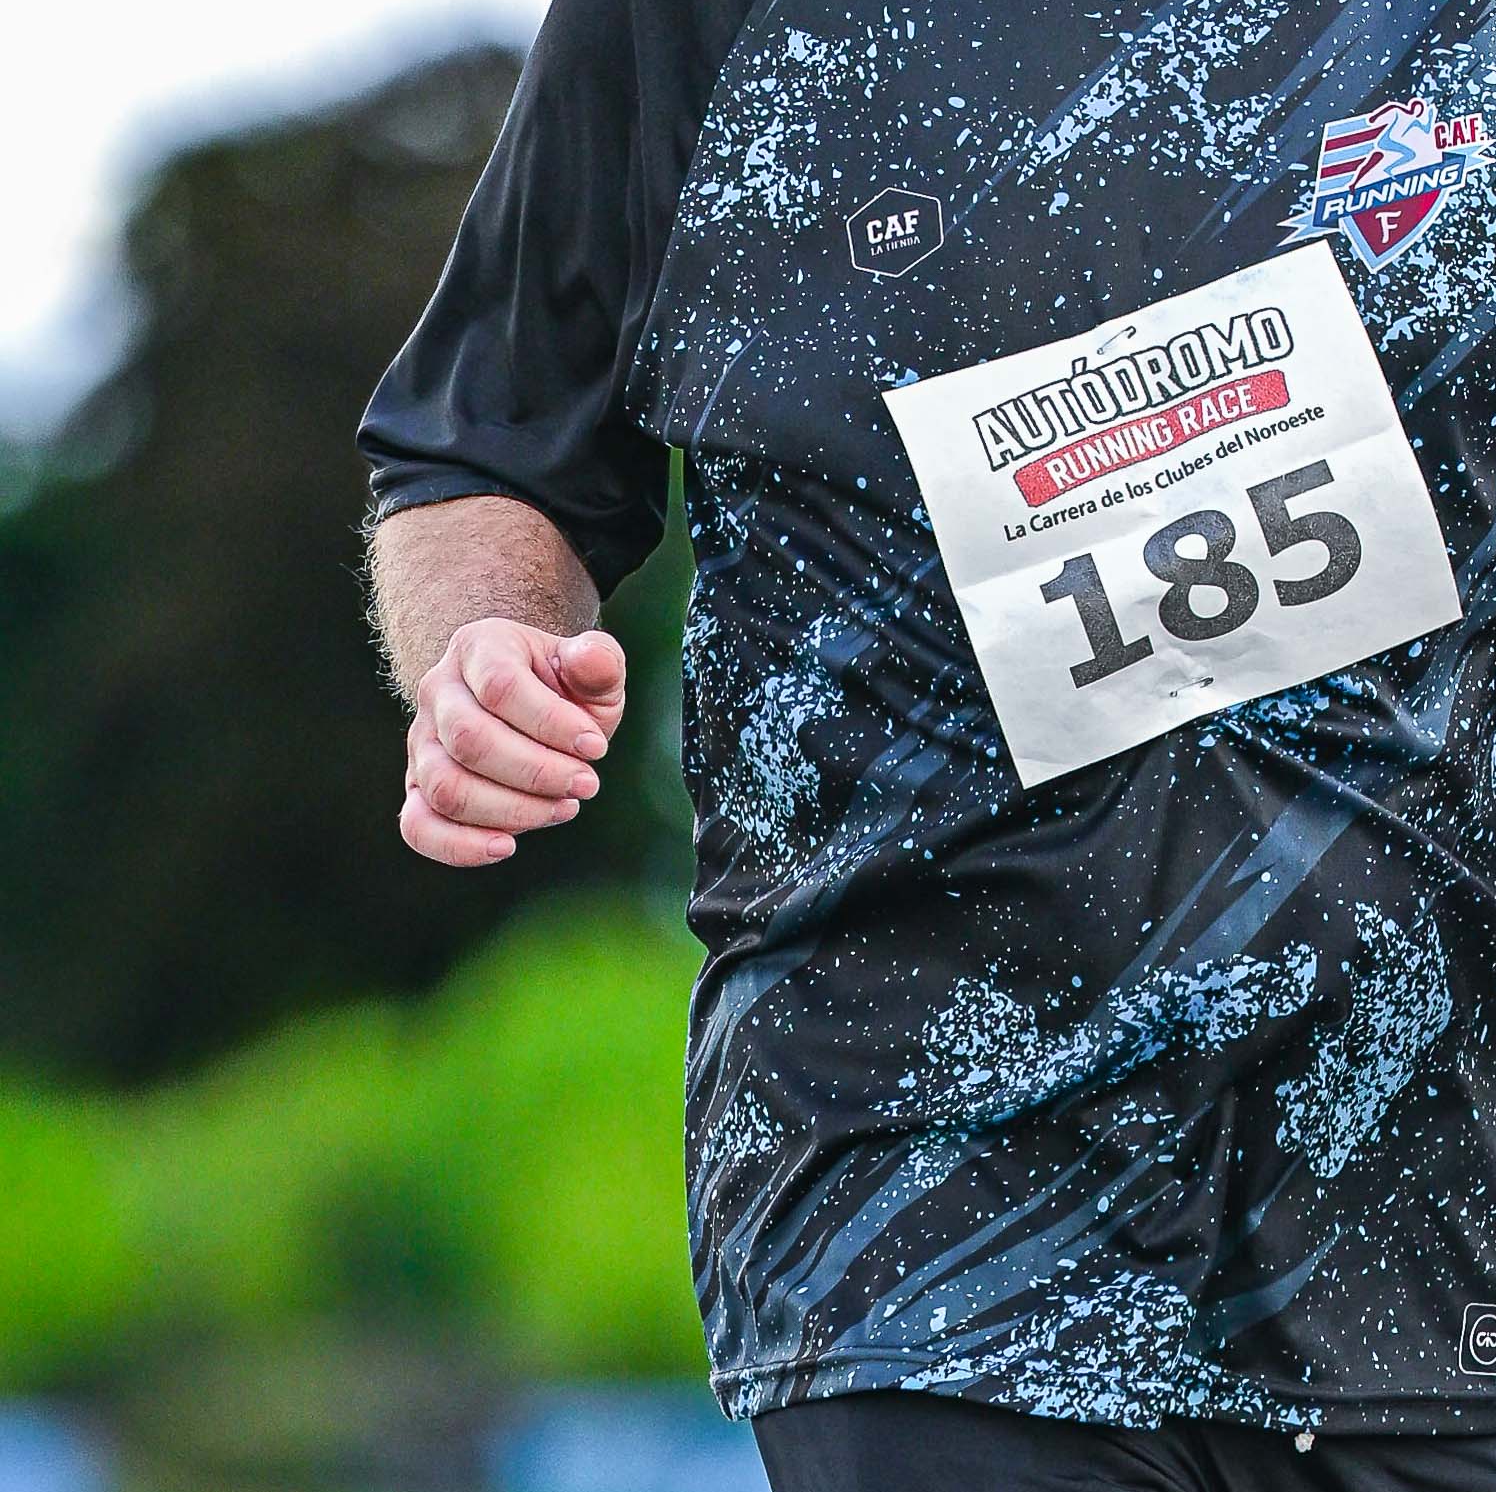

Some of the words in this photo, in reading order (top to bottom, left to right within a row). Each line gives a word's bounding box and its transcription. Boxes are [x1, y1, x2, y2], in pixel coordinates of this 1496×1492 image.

[1434, 117, 1485, 149] C.A.F.
[1322, 163, 1460, 221] RUNNING
[866, 209, 920, 245] CAF
[871, 244, 884, 256] LA
[886, 235, 921, 252] TIENDA
[1375, 210, 1402, 244] F
[972, 307, 1295, 472] AUTÓDROMO
[1045, 418, 1175, 490] RUNNING
[1176, 383, 1258, 437] RACE
[1003, 524, 1027, 542] La
[1029, 501, 1098, 533] Carrera
[1101, 485, 1125, 506] de
[1127, 479, 1153, 500] los
[1155, 452, 1214, 490] Clubes
[1215, 434, 1245, 460] del
[1248, 405, 1326, 447] Noroeste
[1039, 458, 1363, 690] 185
